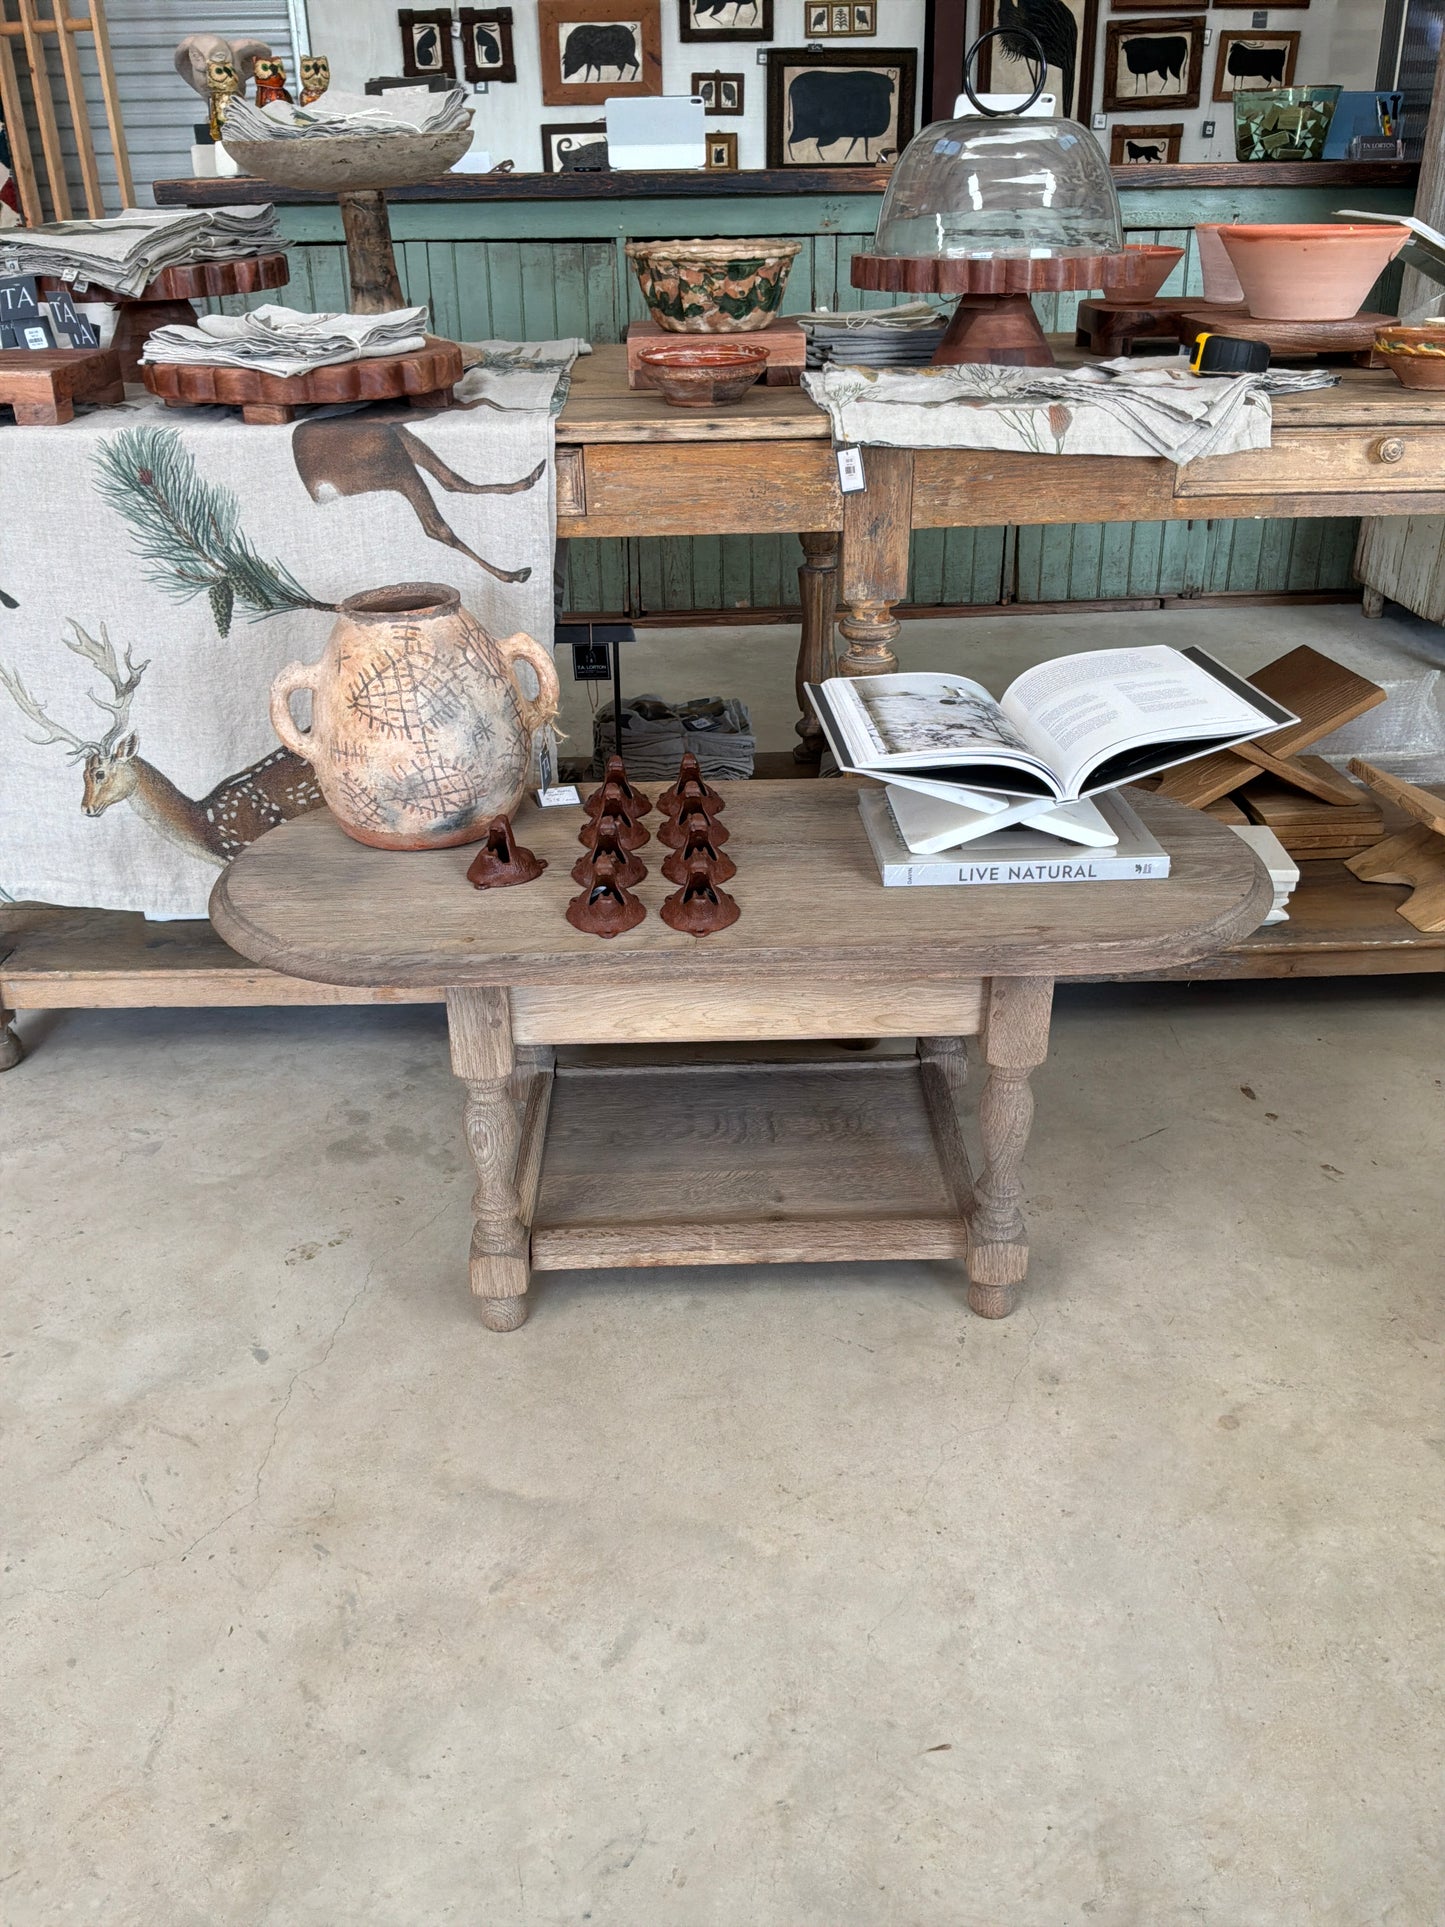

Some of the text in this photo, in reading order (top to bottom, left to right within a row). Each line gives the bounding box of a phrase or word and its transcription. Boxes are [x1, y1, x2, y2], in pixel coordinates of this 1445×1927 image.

[0, 286, 35, 310] TA
[49, 301, 77, 324] TA
[958, 864, 1097, 882] LIVE NATURAL
